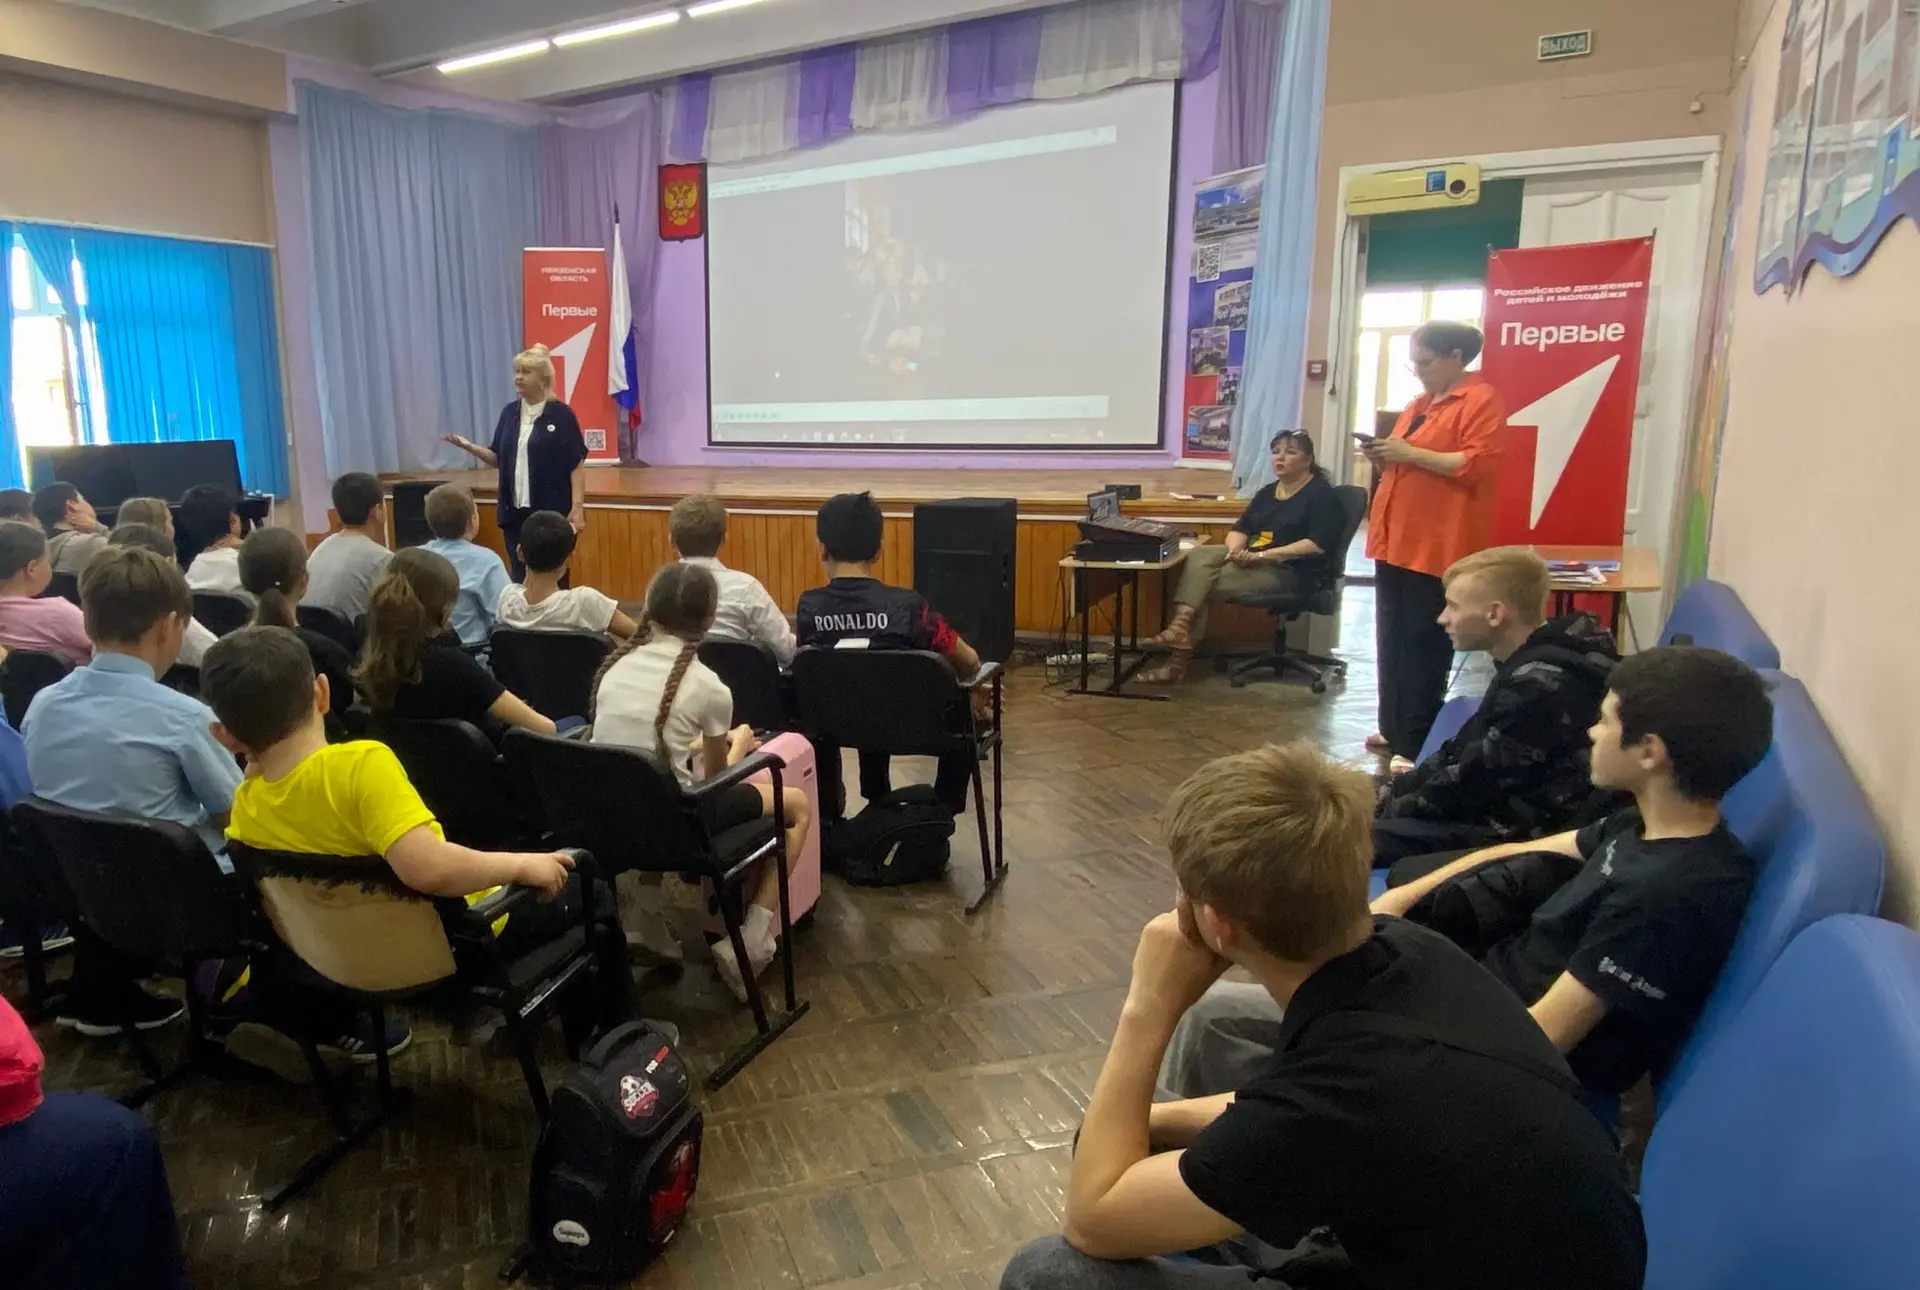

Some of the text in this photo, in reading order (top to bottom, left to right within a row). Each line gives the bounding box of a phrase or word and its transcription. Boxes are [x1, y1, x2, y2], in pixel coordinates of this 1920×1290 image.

[1494, 281, 1643, 297] Российское движение
[1506, 296, 1544, 305] детей
[542, 303, 598, 320] Первые
[1501, 322, 1625, 352] Первые
[814, 612, 889, 632] RONALDO
